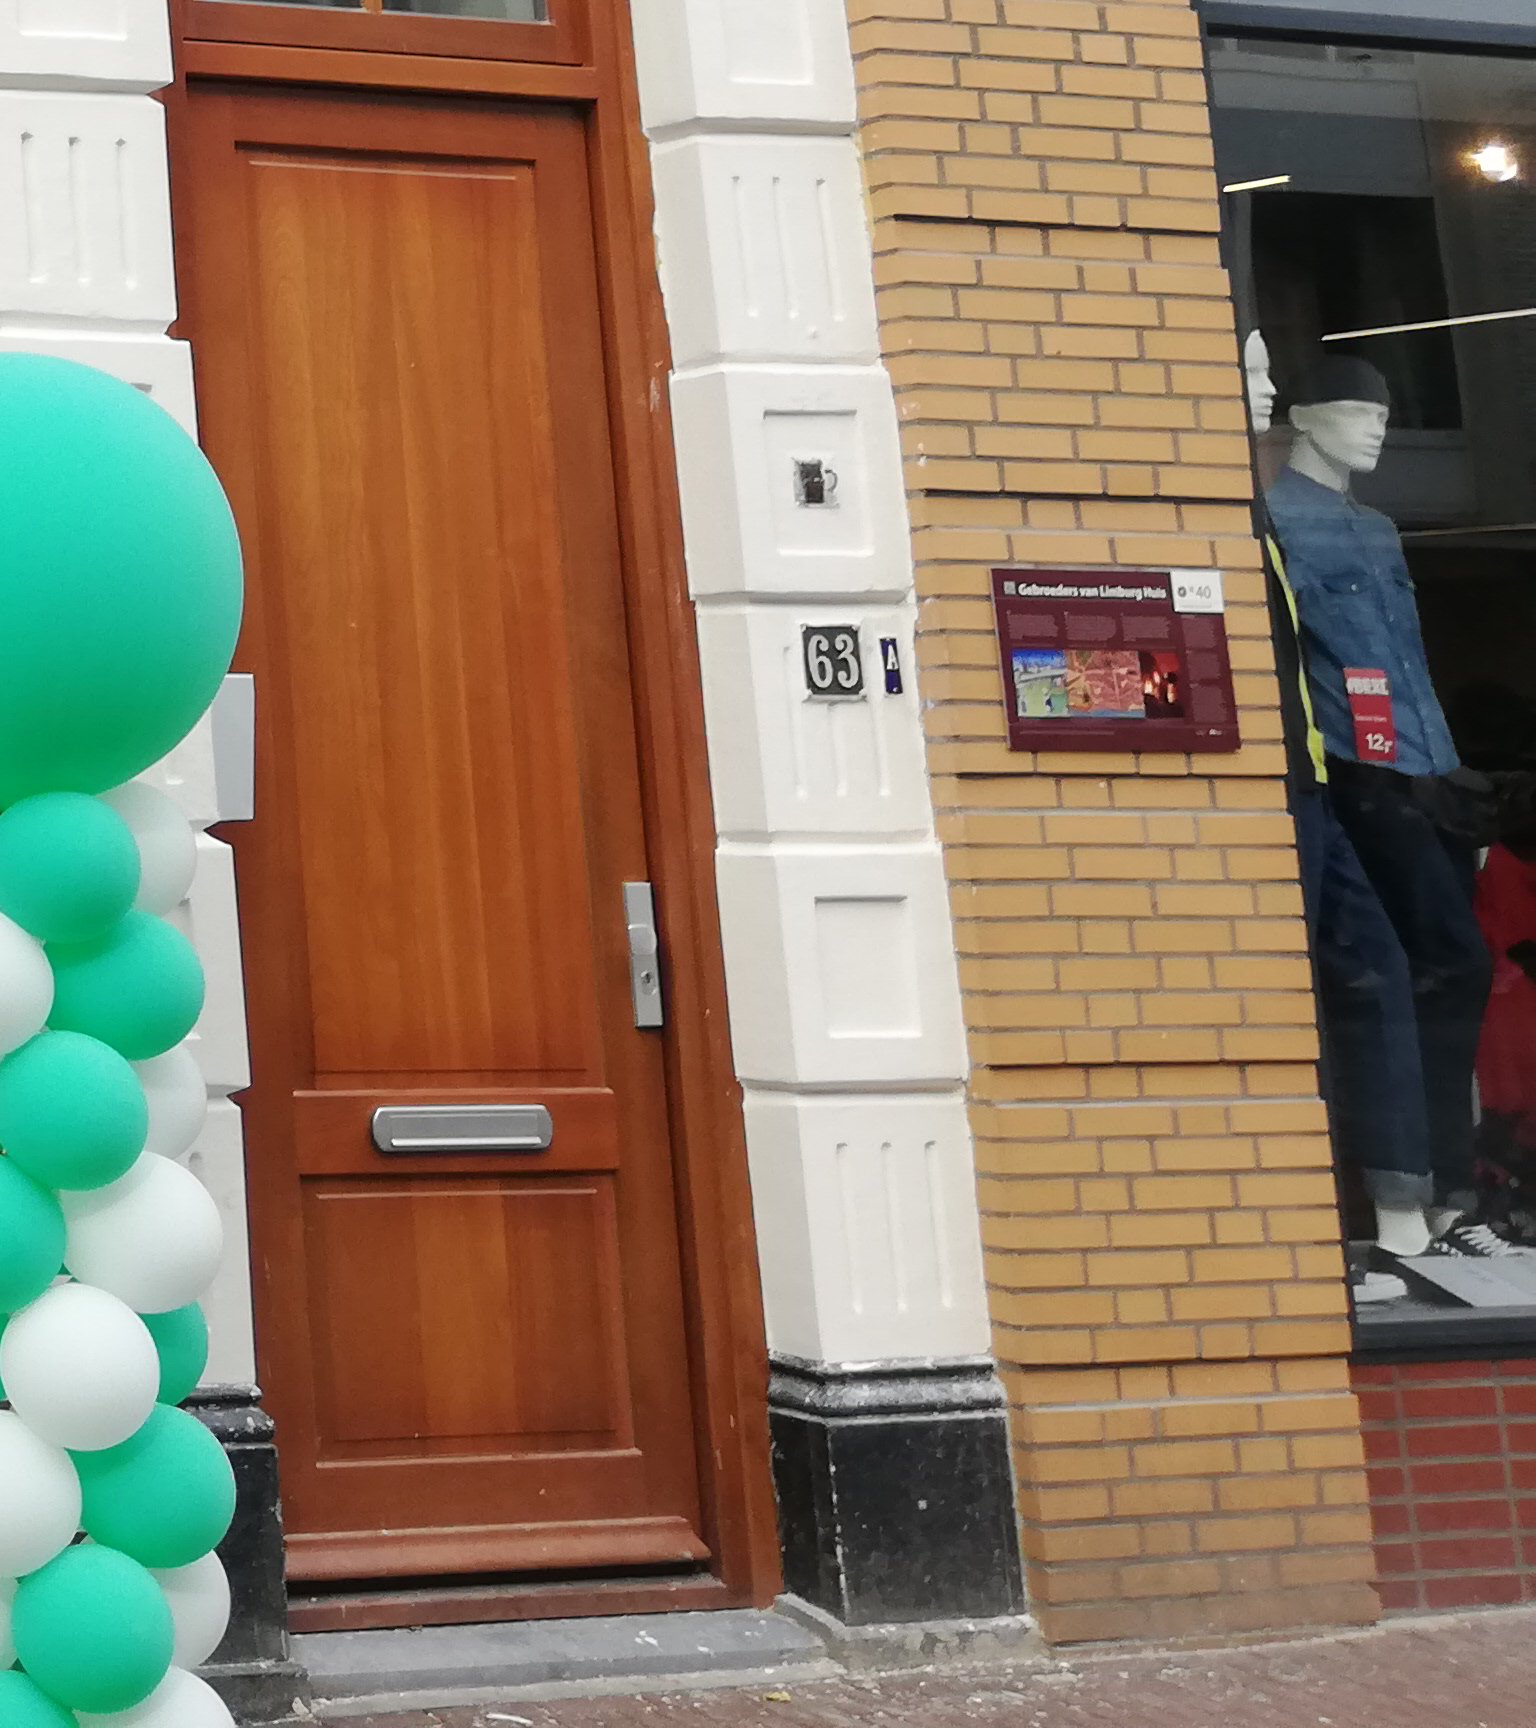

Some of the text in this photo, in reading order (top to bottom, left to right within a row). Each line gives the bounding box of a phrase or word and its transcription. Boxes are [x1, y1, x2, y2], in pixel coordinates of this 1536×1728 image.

[1080, 586, 1099, 598] van
[807, 633, 860, 689] 63
[886, 643, 899, 671] A
